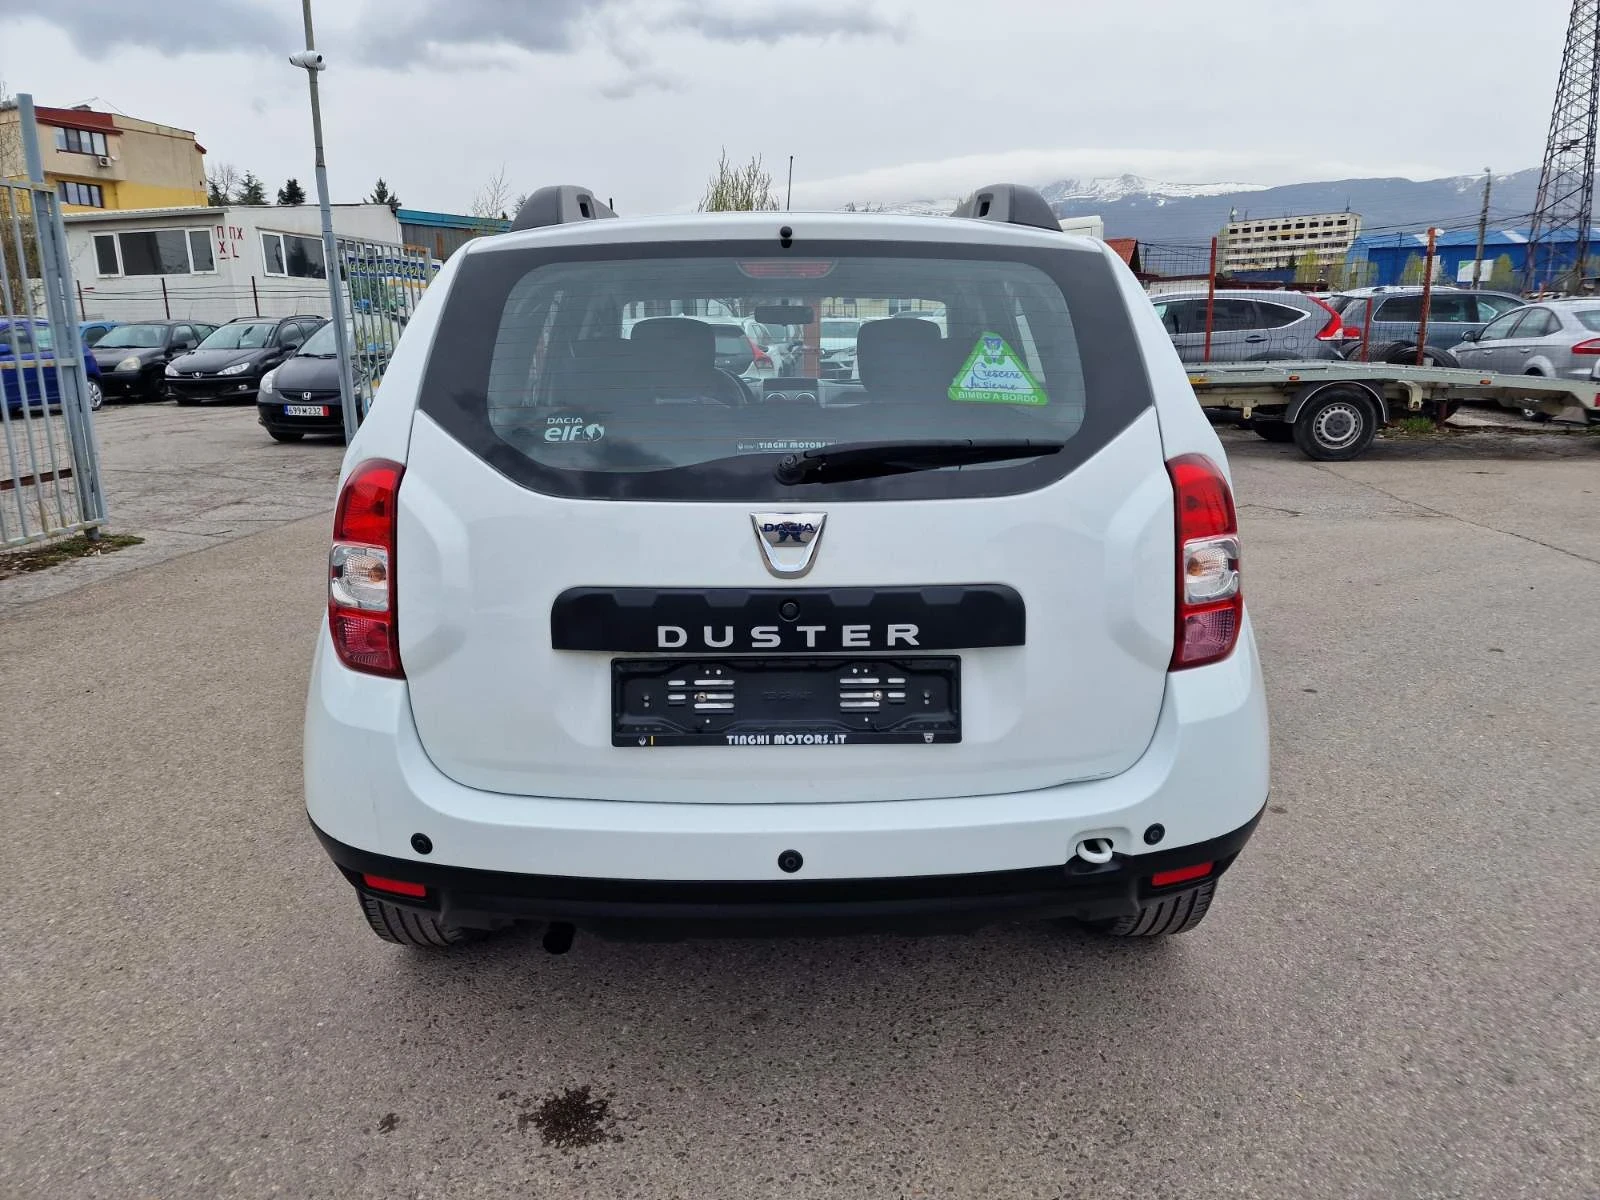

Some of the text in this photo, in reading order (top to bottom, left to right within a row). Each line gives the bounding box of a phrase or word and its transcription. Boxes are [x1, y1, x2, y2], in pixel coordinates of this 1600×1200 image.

[958, 391, 989, 400] BIMBO
[547, 417, 584, 425] DACIA
[544, 425, 583, 442] elf
[657, 624, 920, 648] DUSTER
[726, 734, 848, 745] TINGHI MOTORS.IT
